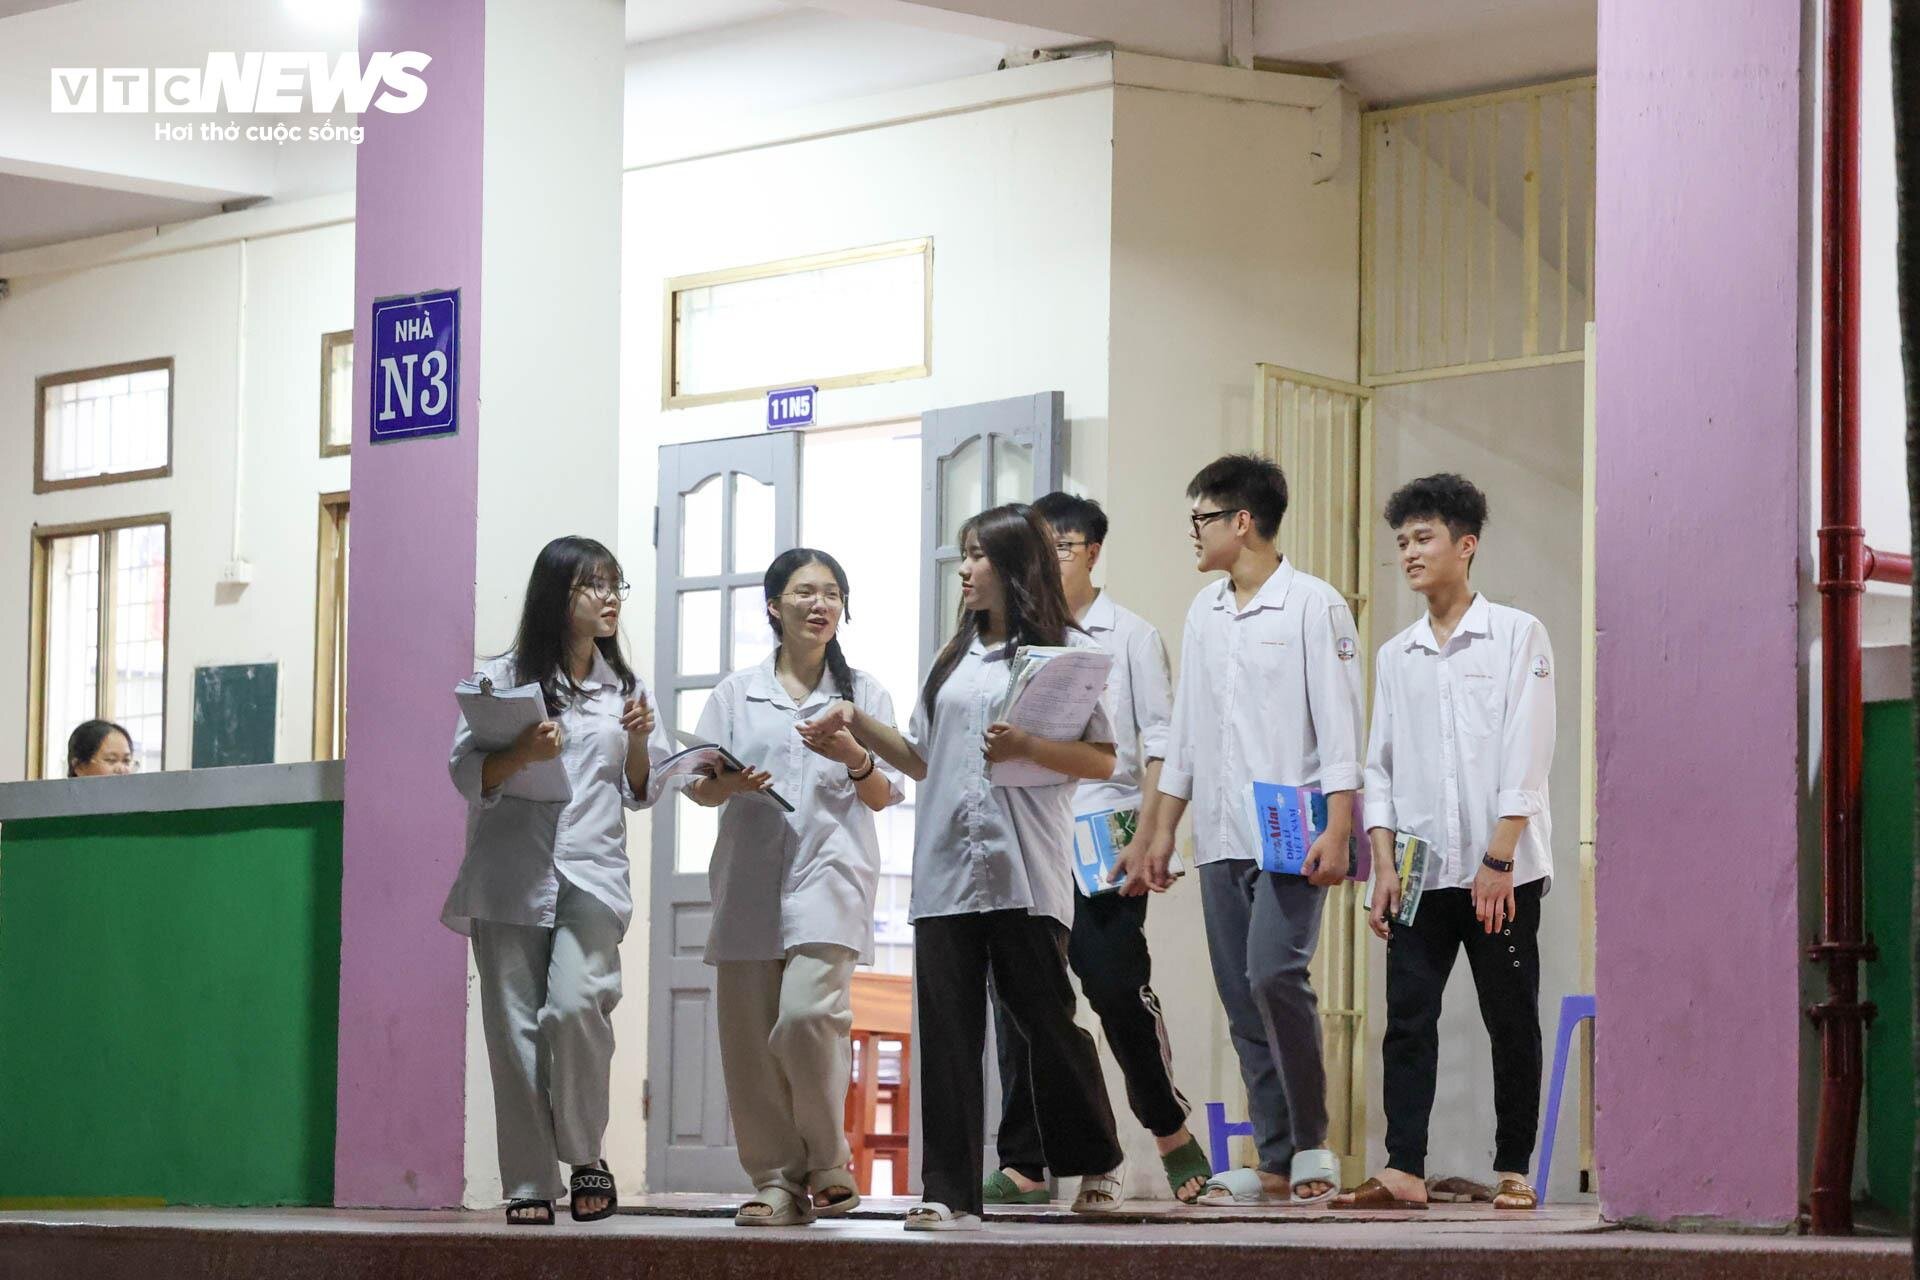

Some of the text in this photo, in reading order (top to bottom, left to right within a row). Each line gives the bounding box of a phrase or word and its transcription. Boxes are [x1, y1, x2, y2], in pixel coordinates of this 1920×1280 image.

[395, 310, 434, 343] NHÀ
[379, 350, 448, 421] N3
[771, 395, 810, 420] 11N5
